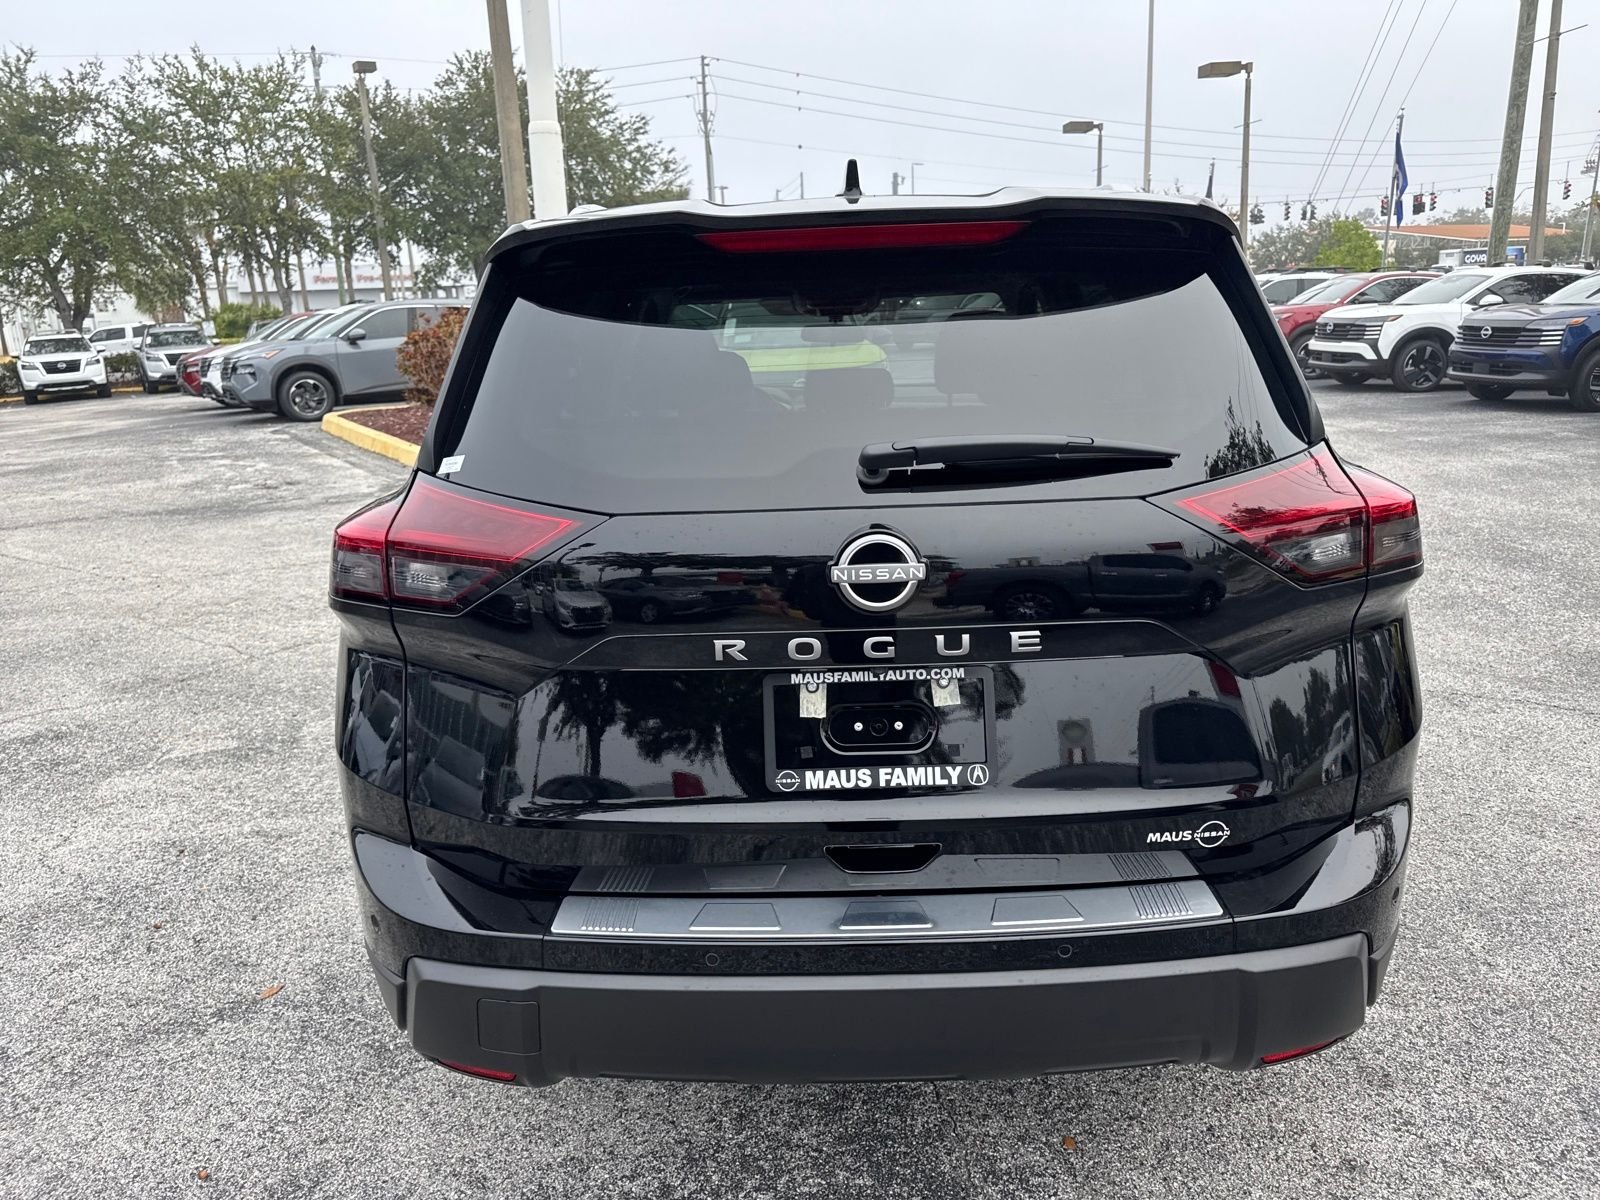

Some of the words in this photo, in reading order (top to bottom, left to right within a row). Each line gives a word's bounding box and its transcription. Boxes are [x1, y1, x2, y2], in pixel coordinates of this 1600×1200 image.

[833, 566, 923, 581] NISSAN
[713, 630, 1043, 661] ROGUE
[790, 667, 965, 684] MAUSFAMILYAUTO.COM
[804, 768, 873, 790] MAUS
[878, 766, 963, 788] FAMILY
[1146, 830, 1192, 843] MAUS
[1193, 830, 1231, 838] NISSAN
